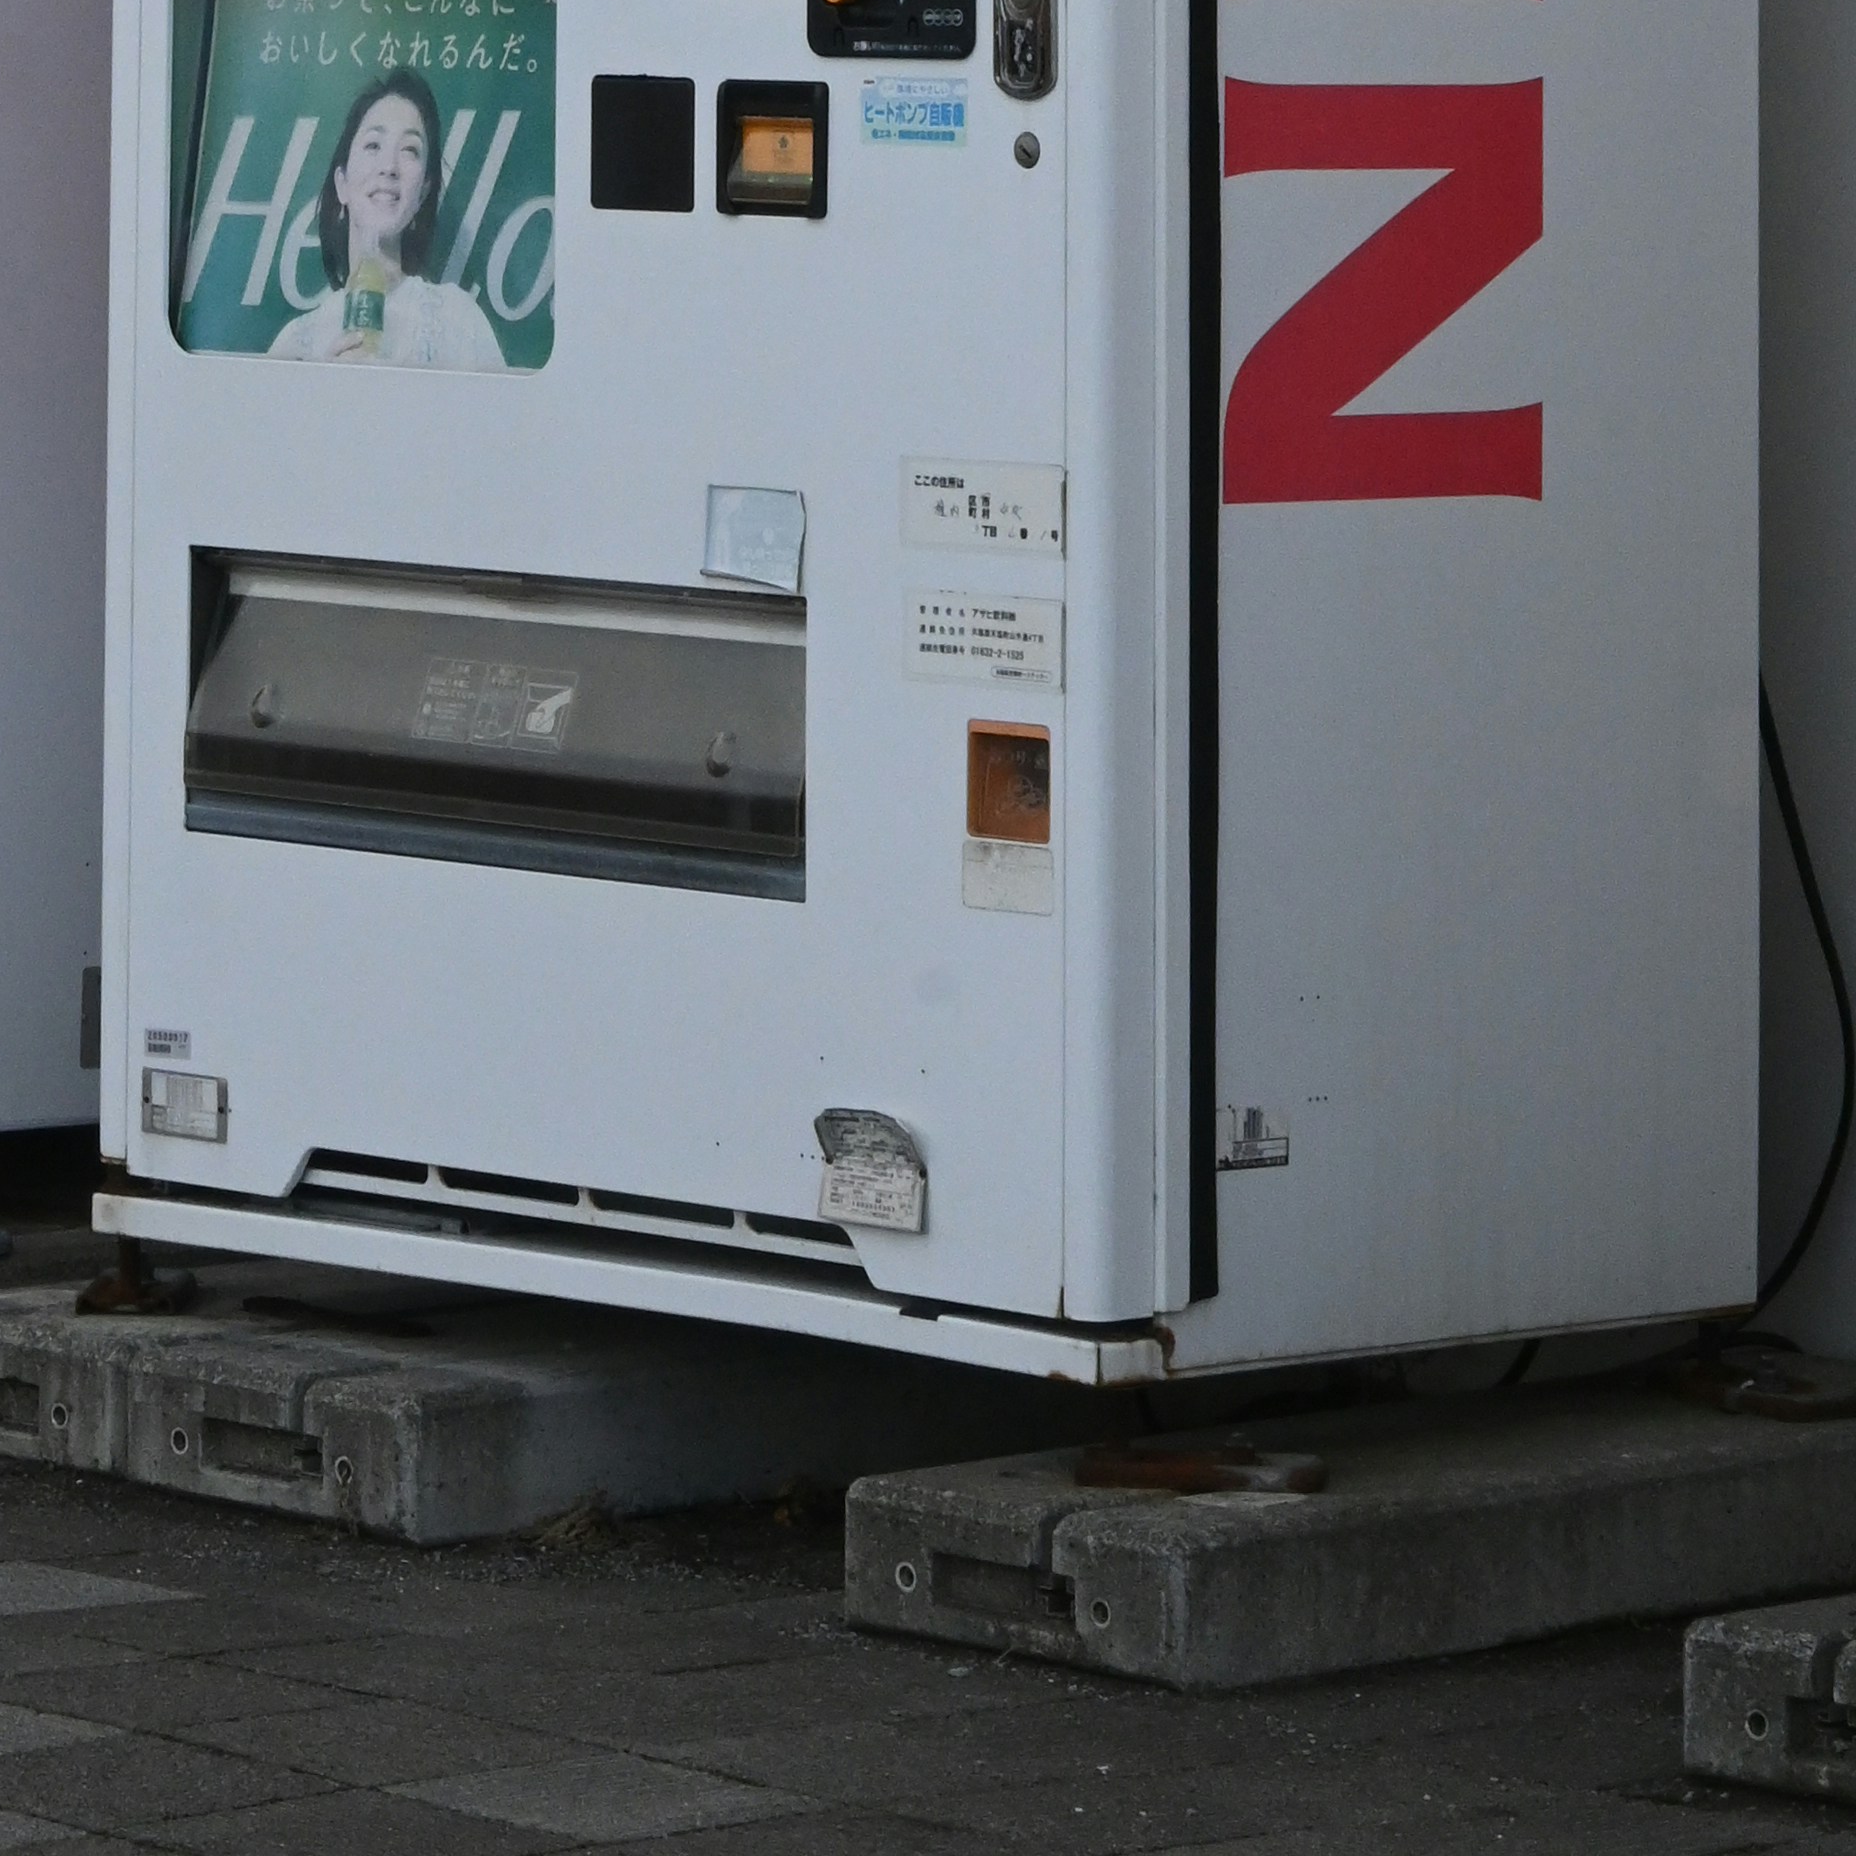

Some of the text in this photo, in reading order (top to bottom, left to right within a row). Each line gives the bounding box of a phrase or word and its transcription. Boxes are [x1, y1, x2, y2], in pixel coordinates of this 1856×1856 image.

[259, 31, 538, 74] おいしくなれるんだ。
[864, 101, 965, 127] ヒートポンプ自販機
[914, 474, 964, 489] ここの住所は
